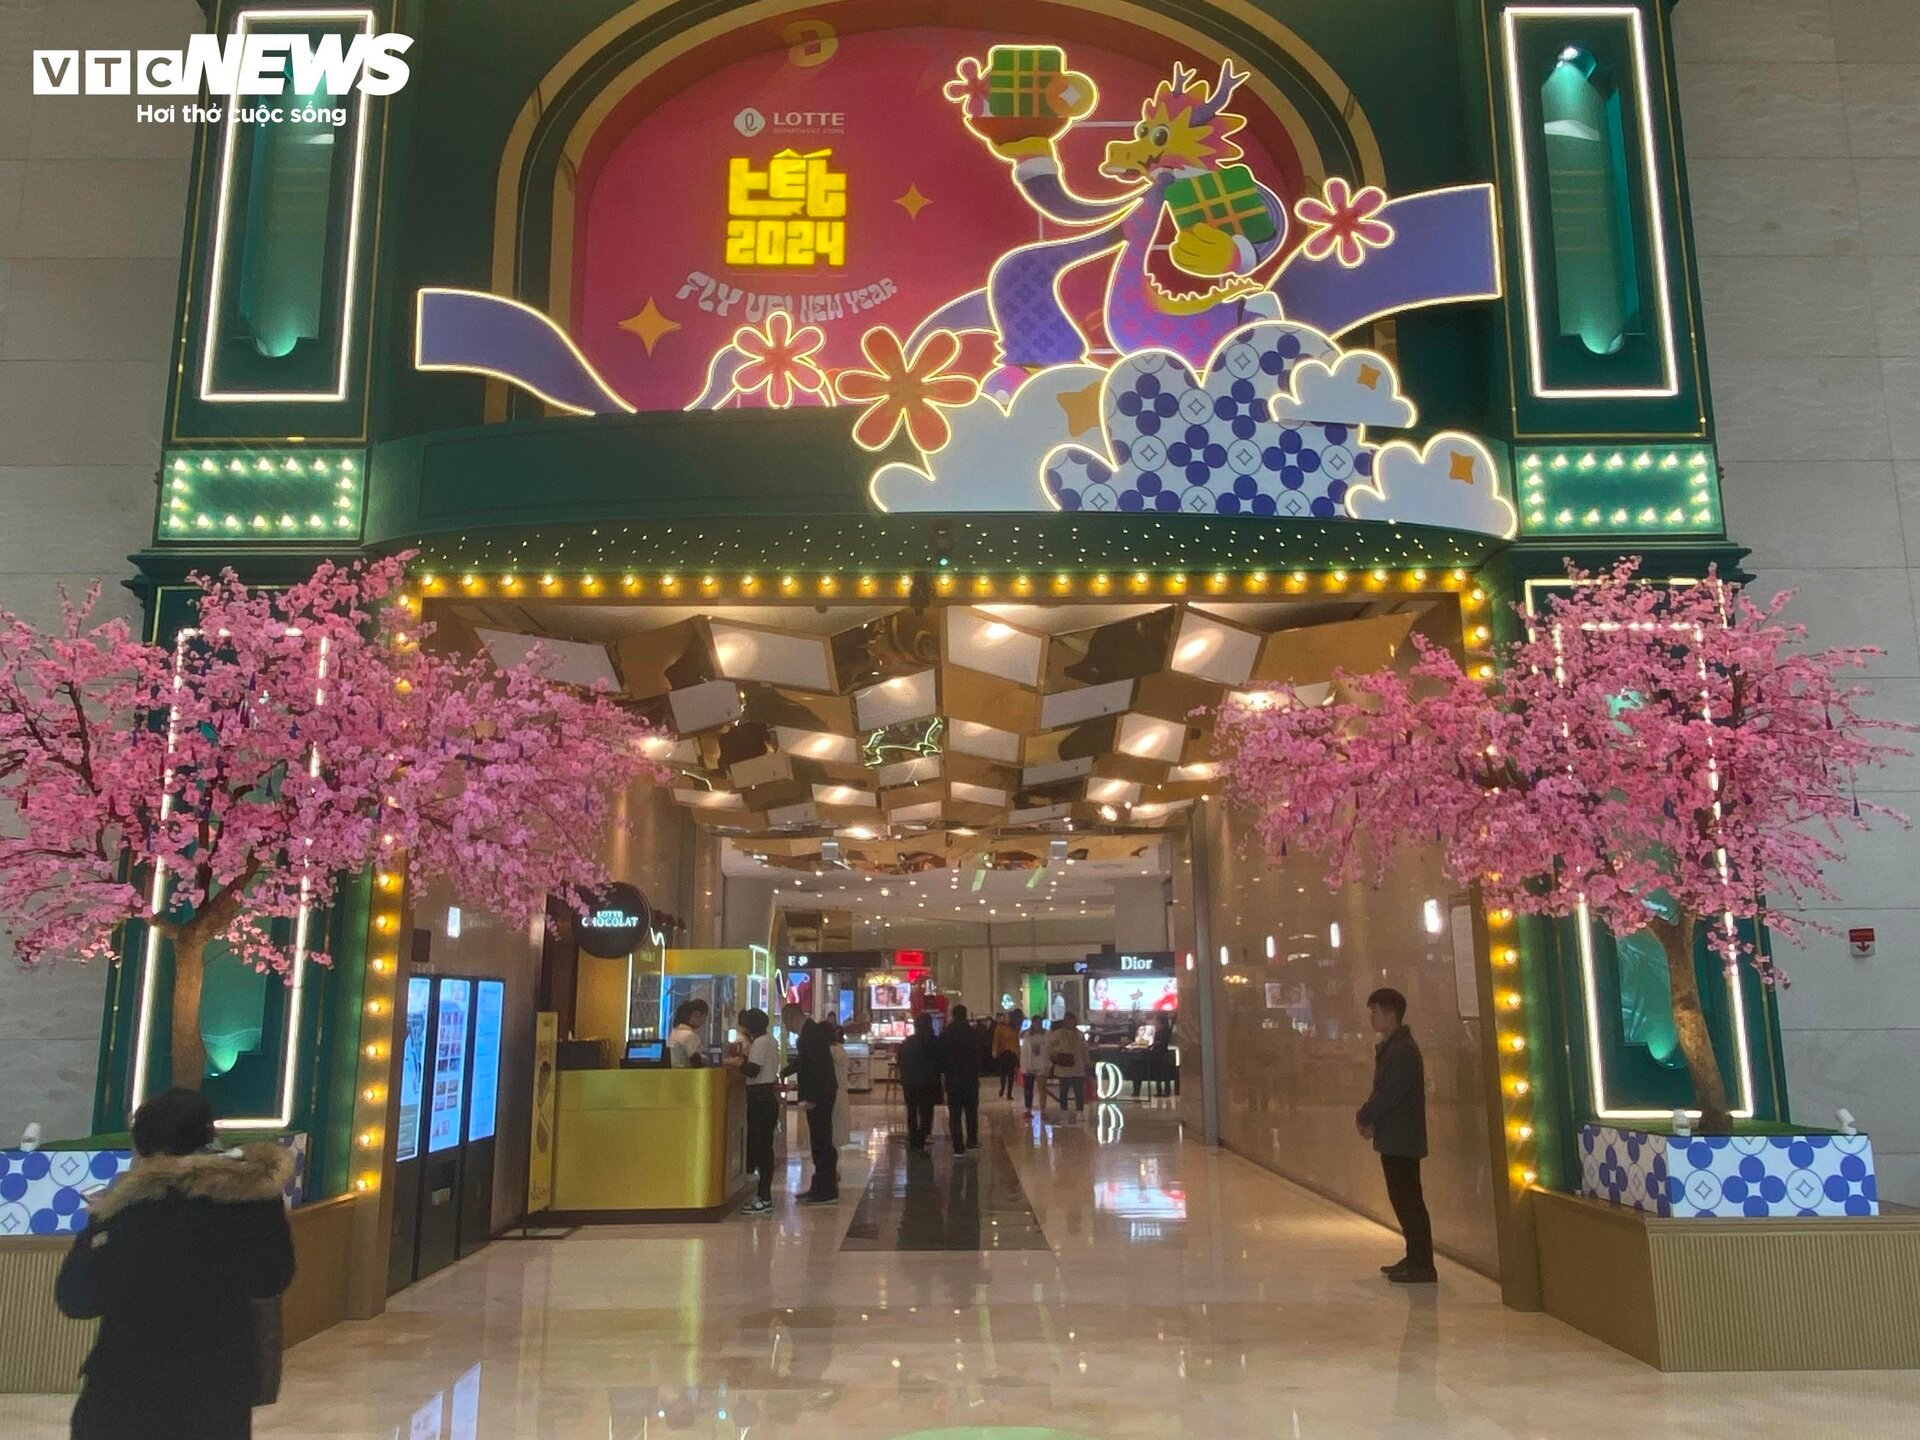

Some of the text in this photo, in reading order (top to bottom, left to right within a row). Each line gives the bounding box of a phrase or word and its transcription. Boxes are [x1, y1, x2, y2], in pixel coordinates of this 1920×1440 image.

[773, 112, 845, 126] LOTTE
[726, 220, 845, 266] 2024
[675, 271, 744, 317] FLY
[800, 293, 843, 323] NEW
[844, 277, 898, 314] YEAR
[1120, 956, 1153, 971] Dior
